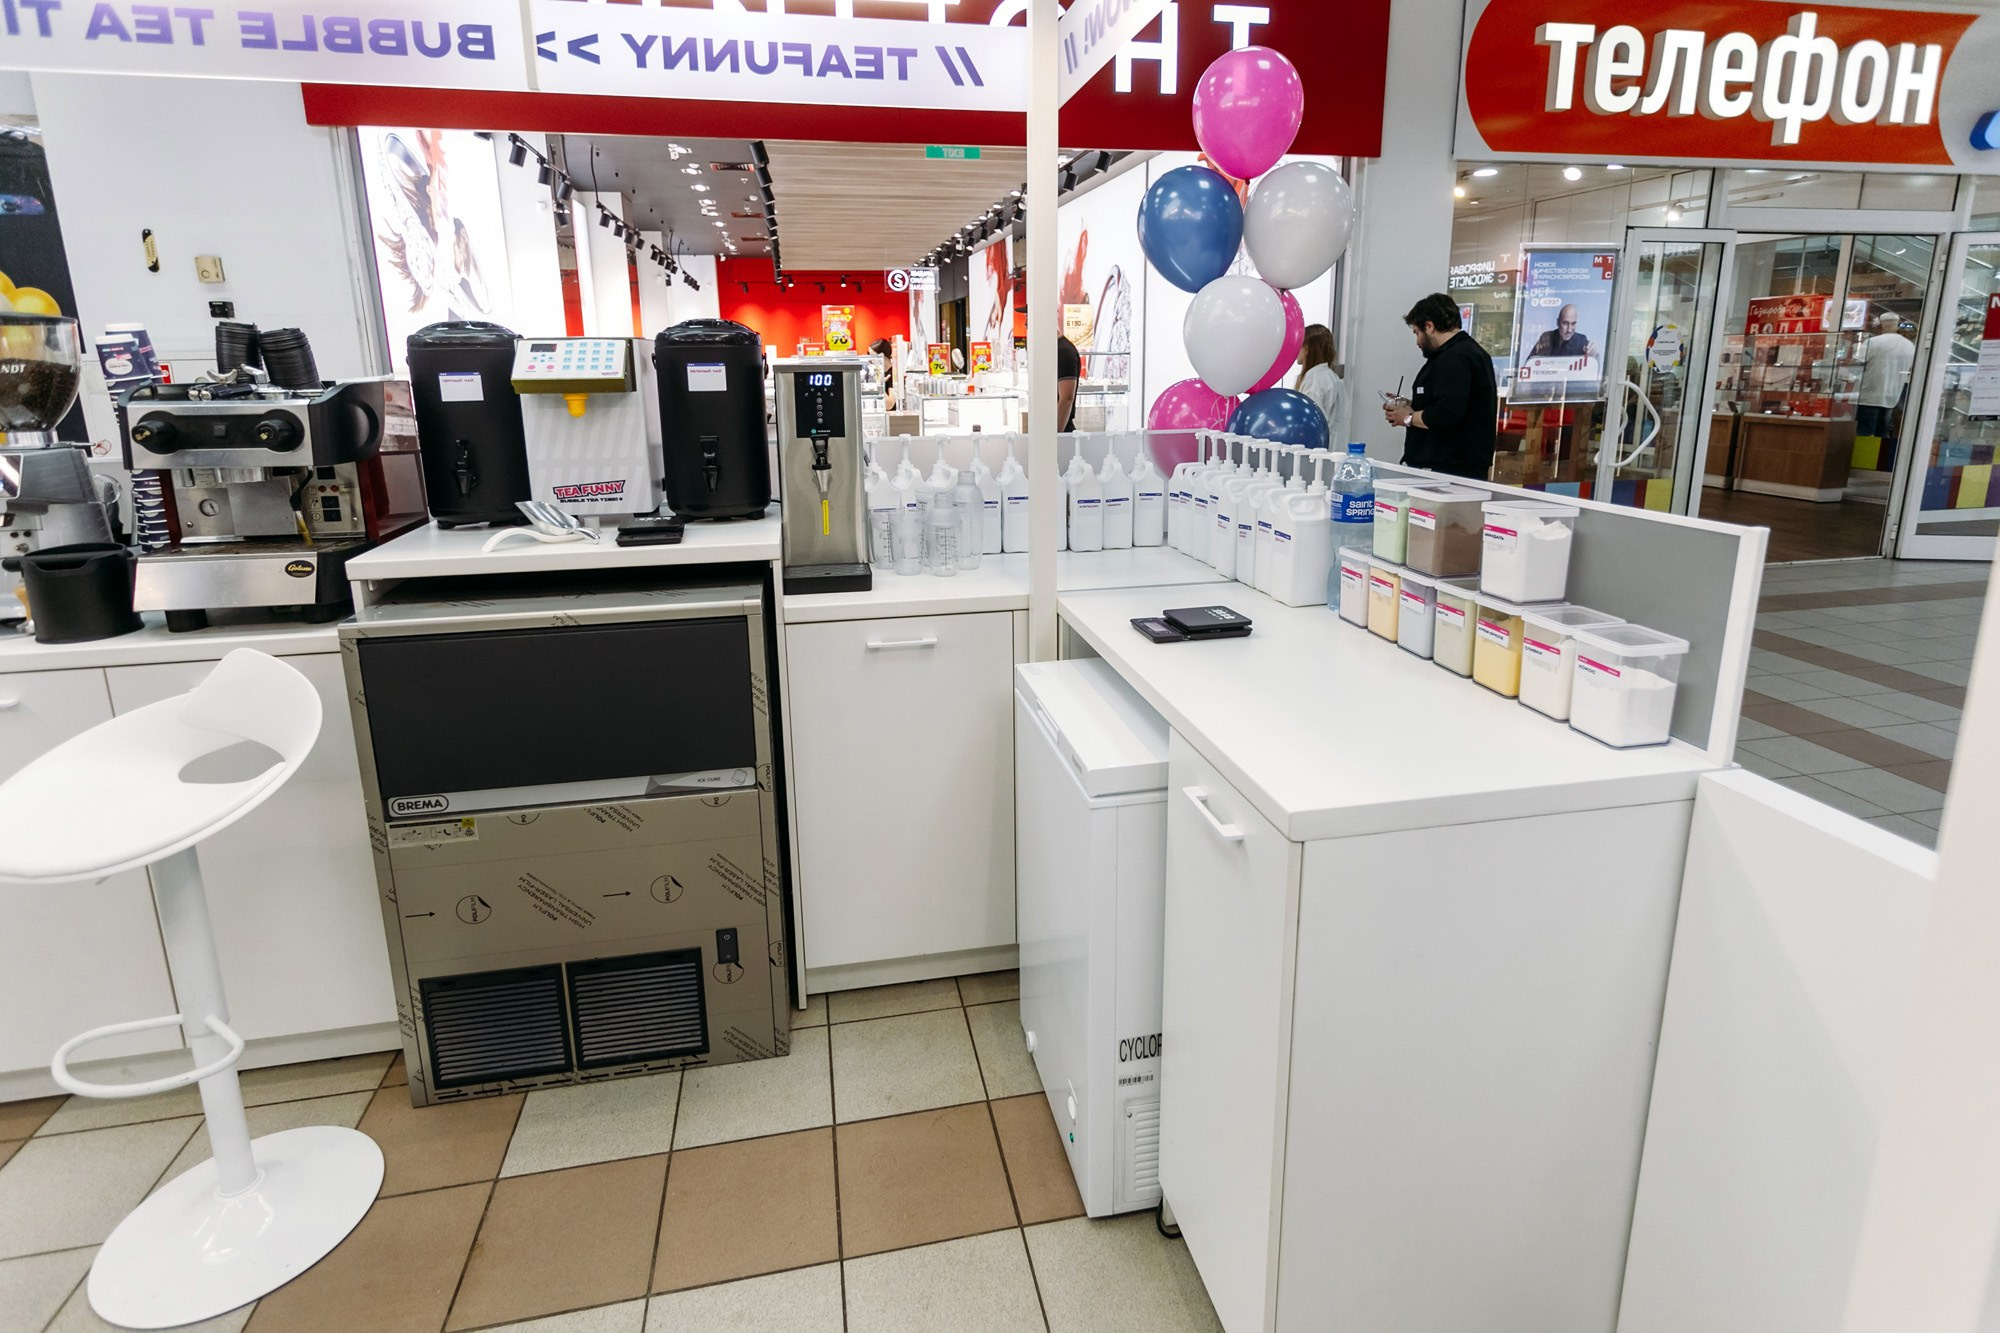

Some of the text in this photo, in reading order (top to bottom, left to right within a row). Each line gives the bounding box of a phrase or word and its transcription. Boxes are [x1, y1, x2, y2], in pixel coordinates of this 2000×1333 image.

[808, 374, 833, 386] 100
[554, 481, 624, 499] TEA FUNNY
[1484, 532, 1505, 541] МИНДАЛЬ
[1524, 645, 1543, 656] СЛИВКИ
[1578, 664, 1596, 675] КОКОС
[397, 799, 444, 811] BREMA
[609, 806, 641, 829] UNIVERSA
[663, 876, 671, 901] POLIFILM
[707, 864, 753, 899] TRANSPARENCY
[744, 880, 766, 899] VERSAL
[470, 897, 479, 922] POLIFILM
[517, 884, 585, 929] HIGH TRANSPARENCY
[519, 876, 592, 926] UNIVERSAL LASER-FILM
[533, 903, 558, 921] POLIFILM
